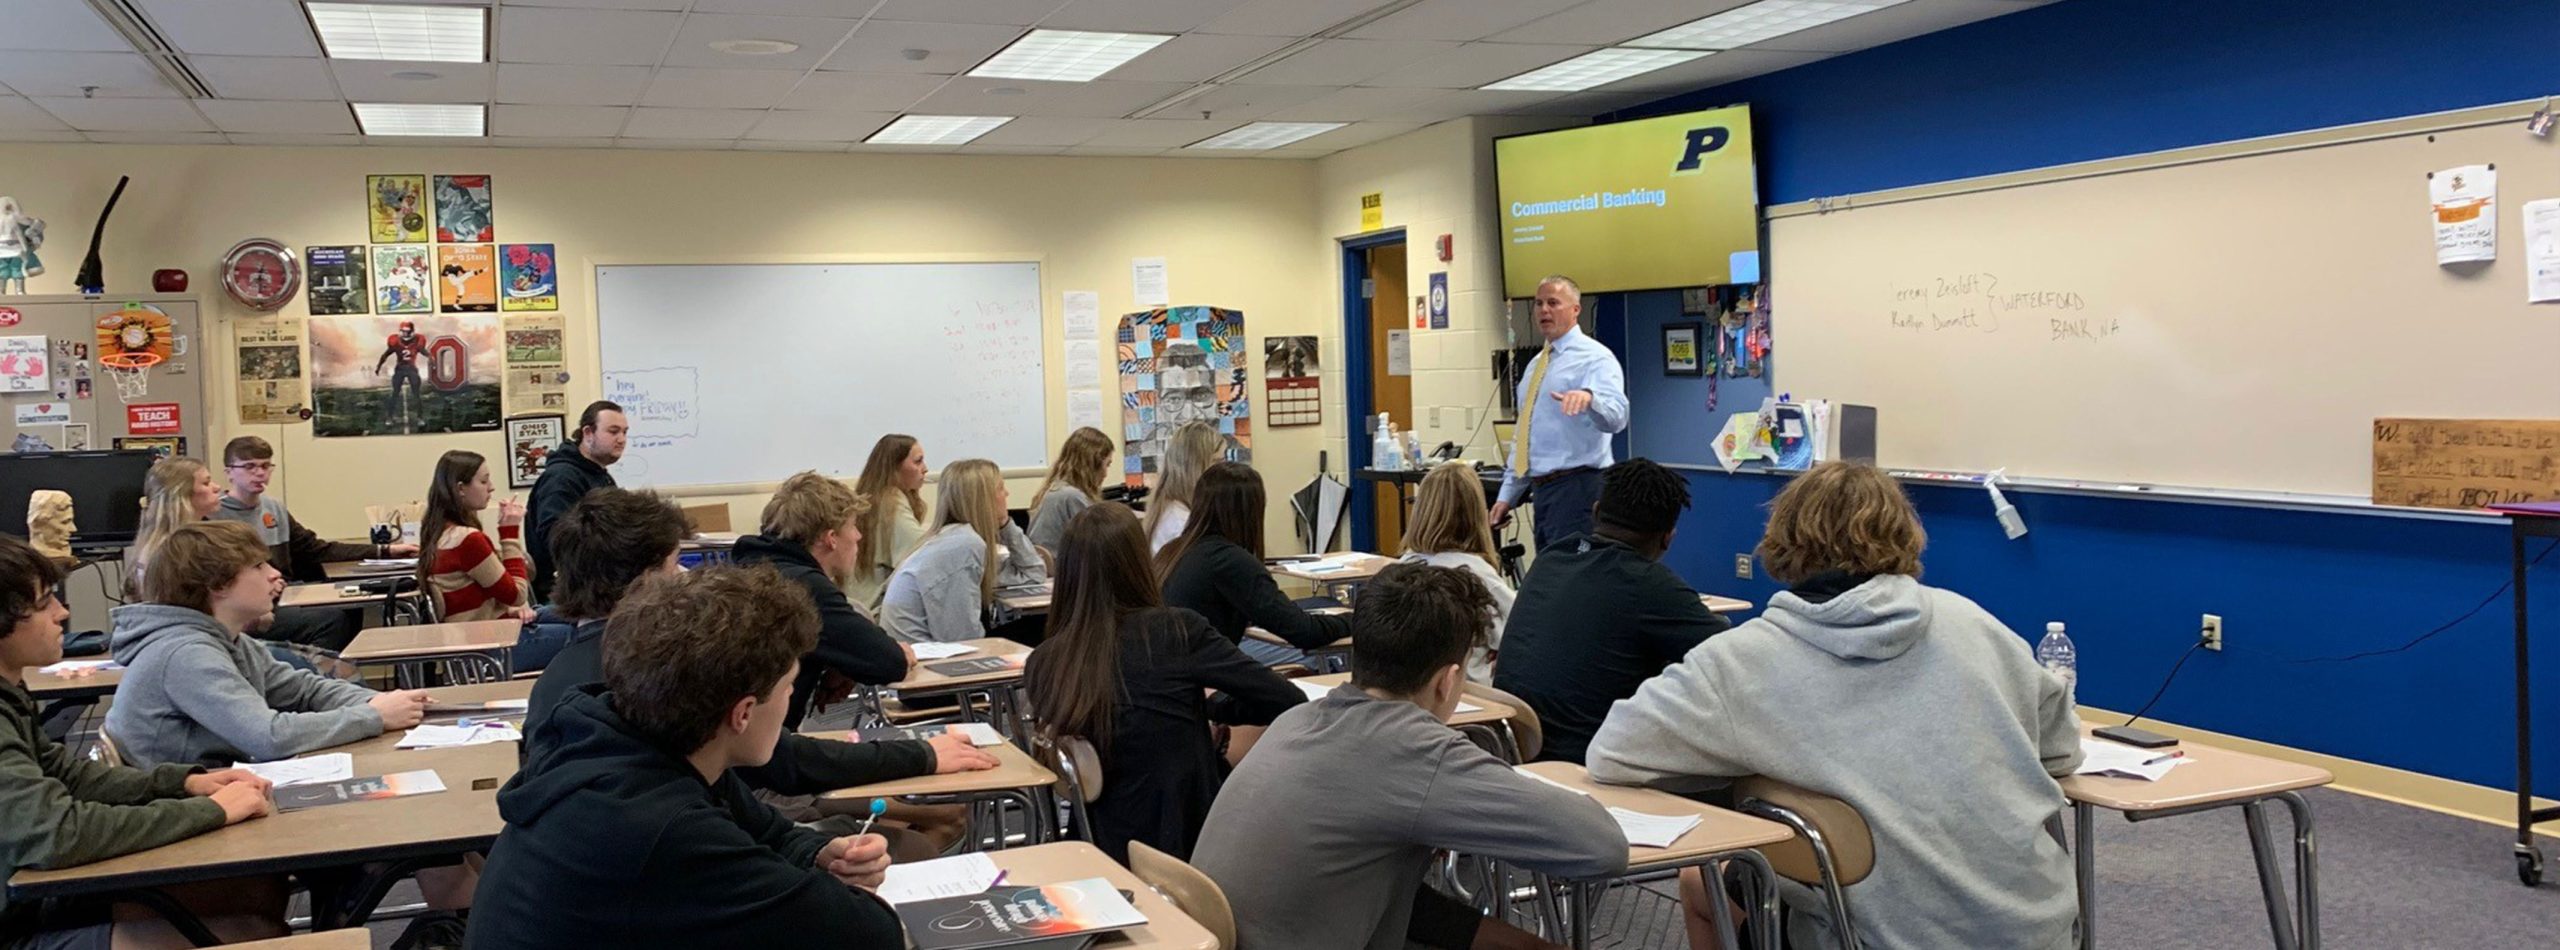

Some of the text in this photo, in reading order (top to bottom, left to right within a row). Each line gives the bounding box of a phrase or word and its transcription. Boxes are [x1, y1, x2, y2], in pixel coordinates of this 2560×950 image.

[1676, 126, 1729, 171] P
[1511, 188, 1665, 217] Commercial Banking
[2000, 291, 2086, 311] WATERFORD
[402, 350, 411, 360] 2
[138, 410, 170, 421] TEACH
[519, 429, 549, 437] STATE
